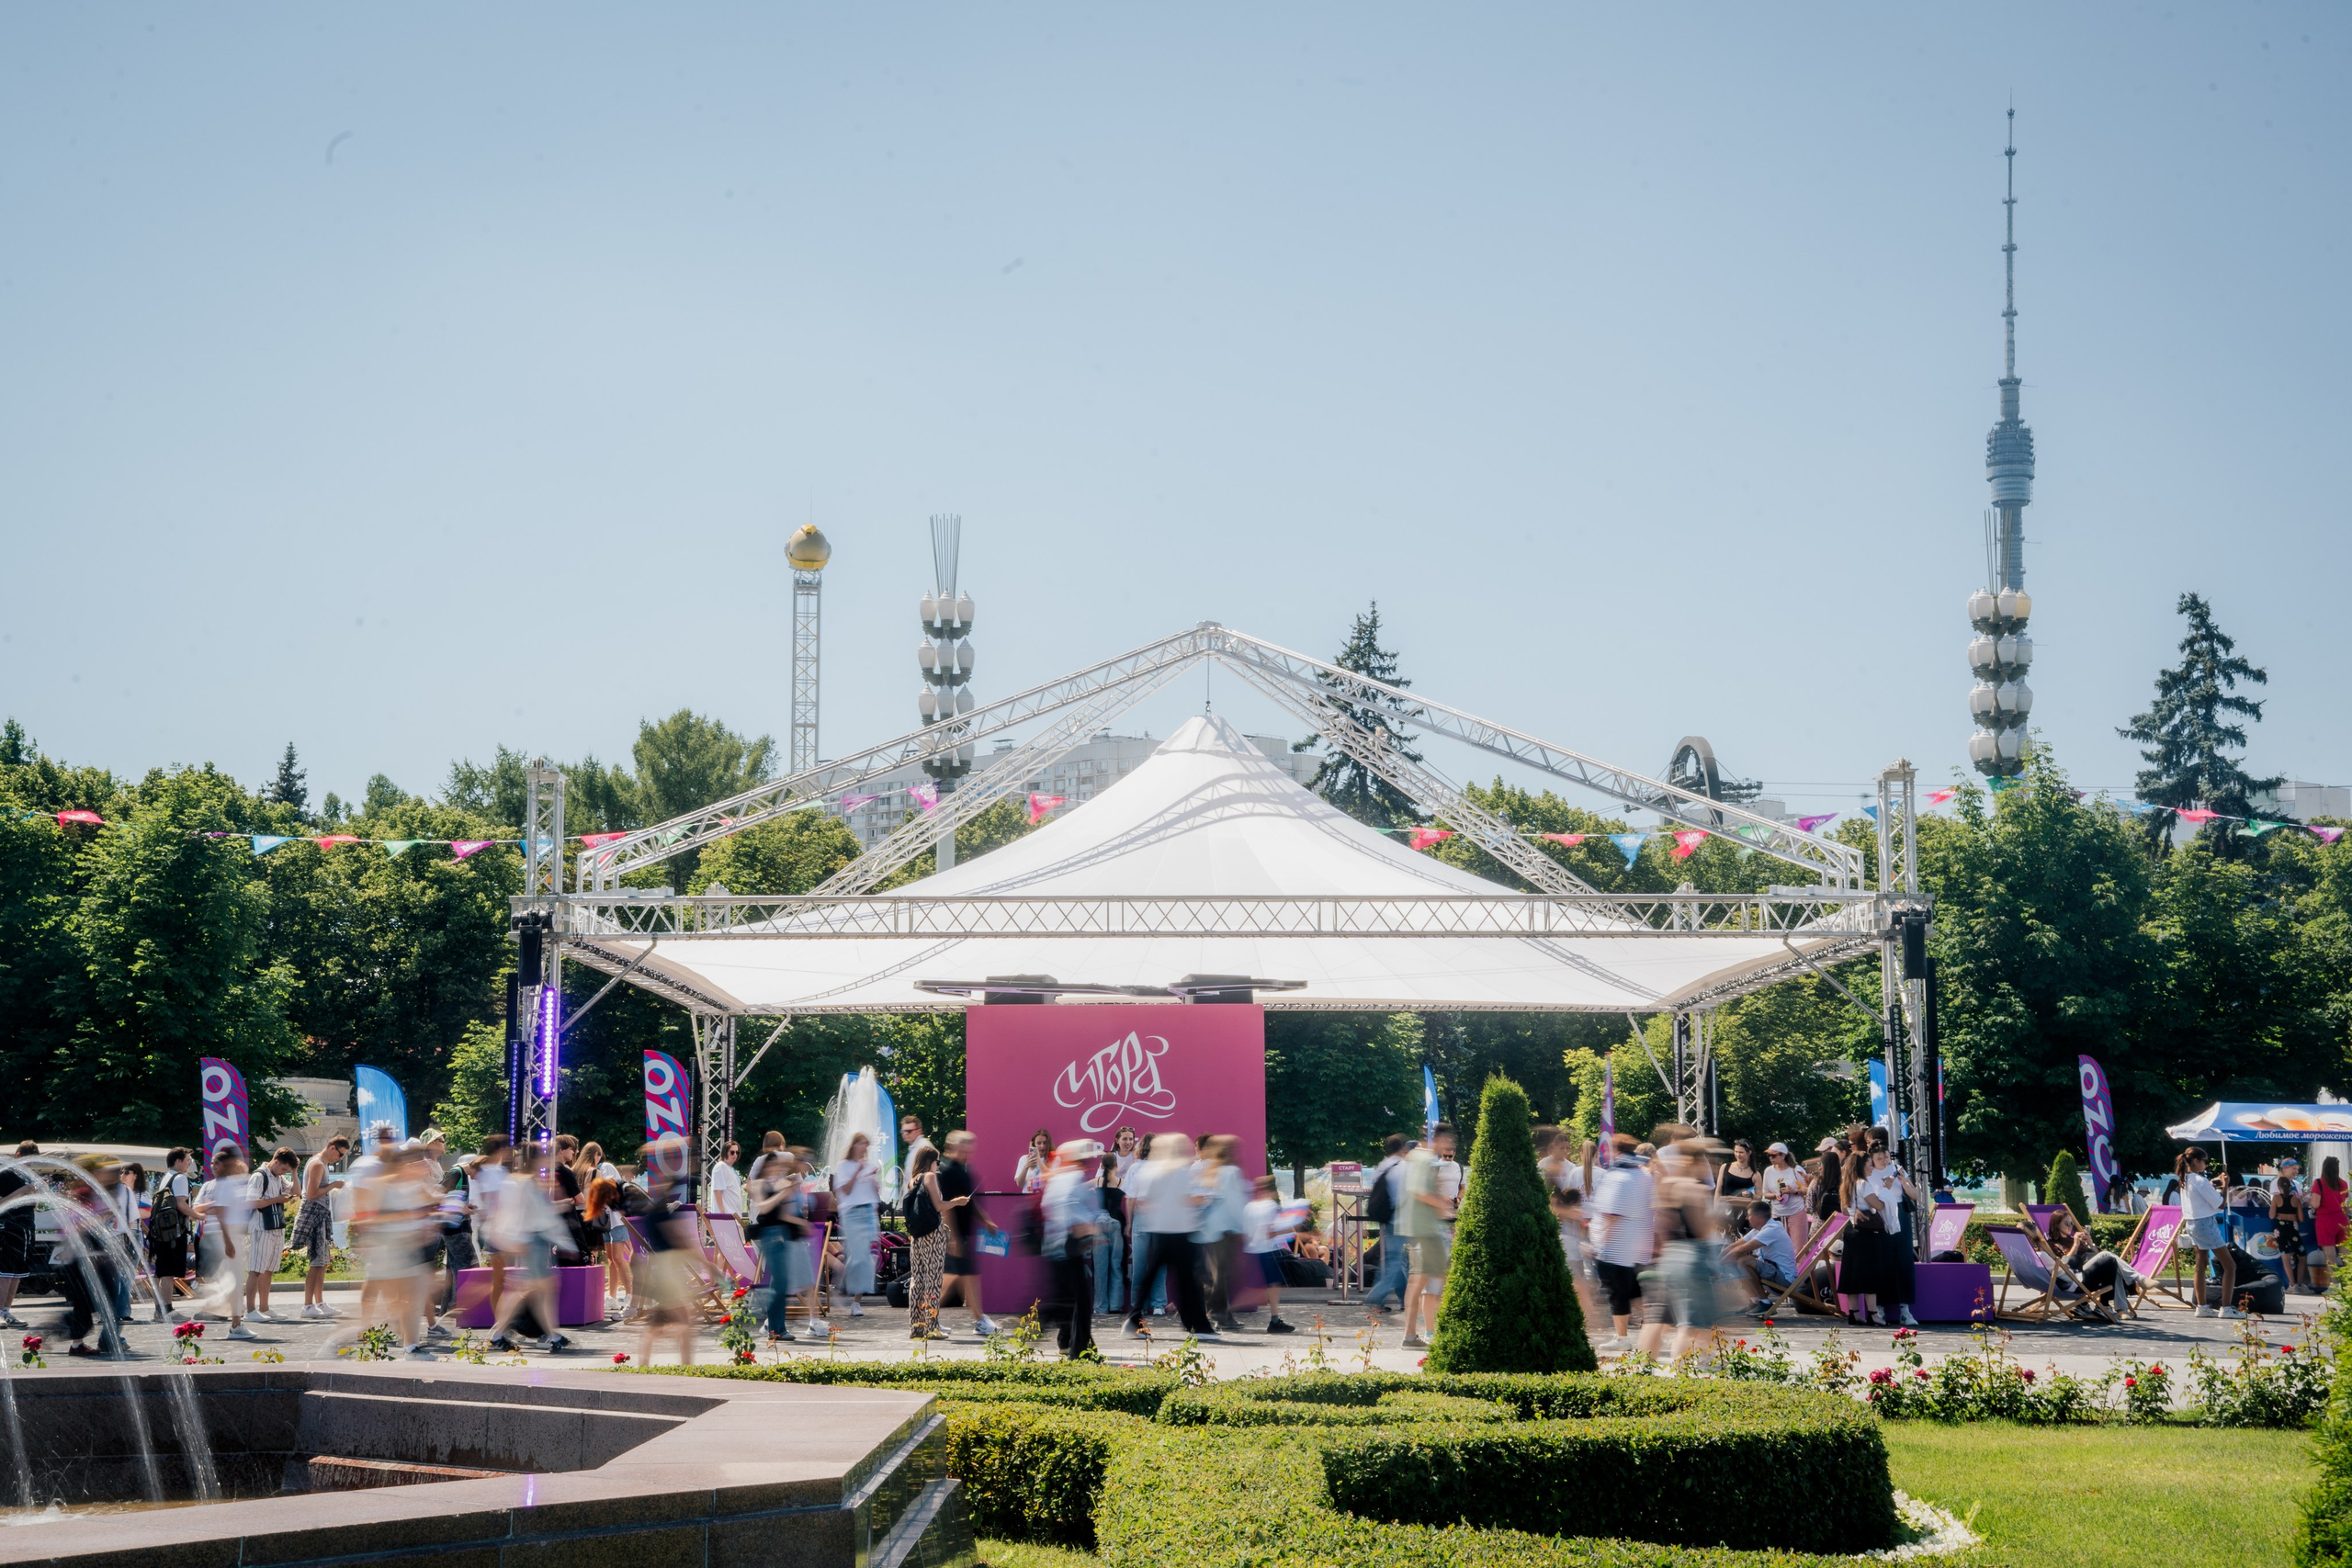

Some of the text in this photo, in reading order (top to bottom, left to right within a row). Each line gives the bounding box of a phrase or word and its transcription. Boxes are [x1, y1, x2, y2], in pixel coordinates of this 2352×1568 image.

[644, 1059, 688, 1203] OZO
[2079, 1063, 2118, 1184] OZO
[2255, 1130, 2300, 1139] Любимое
